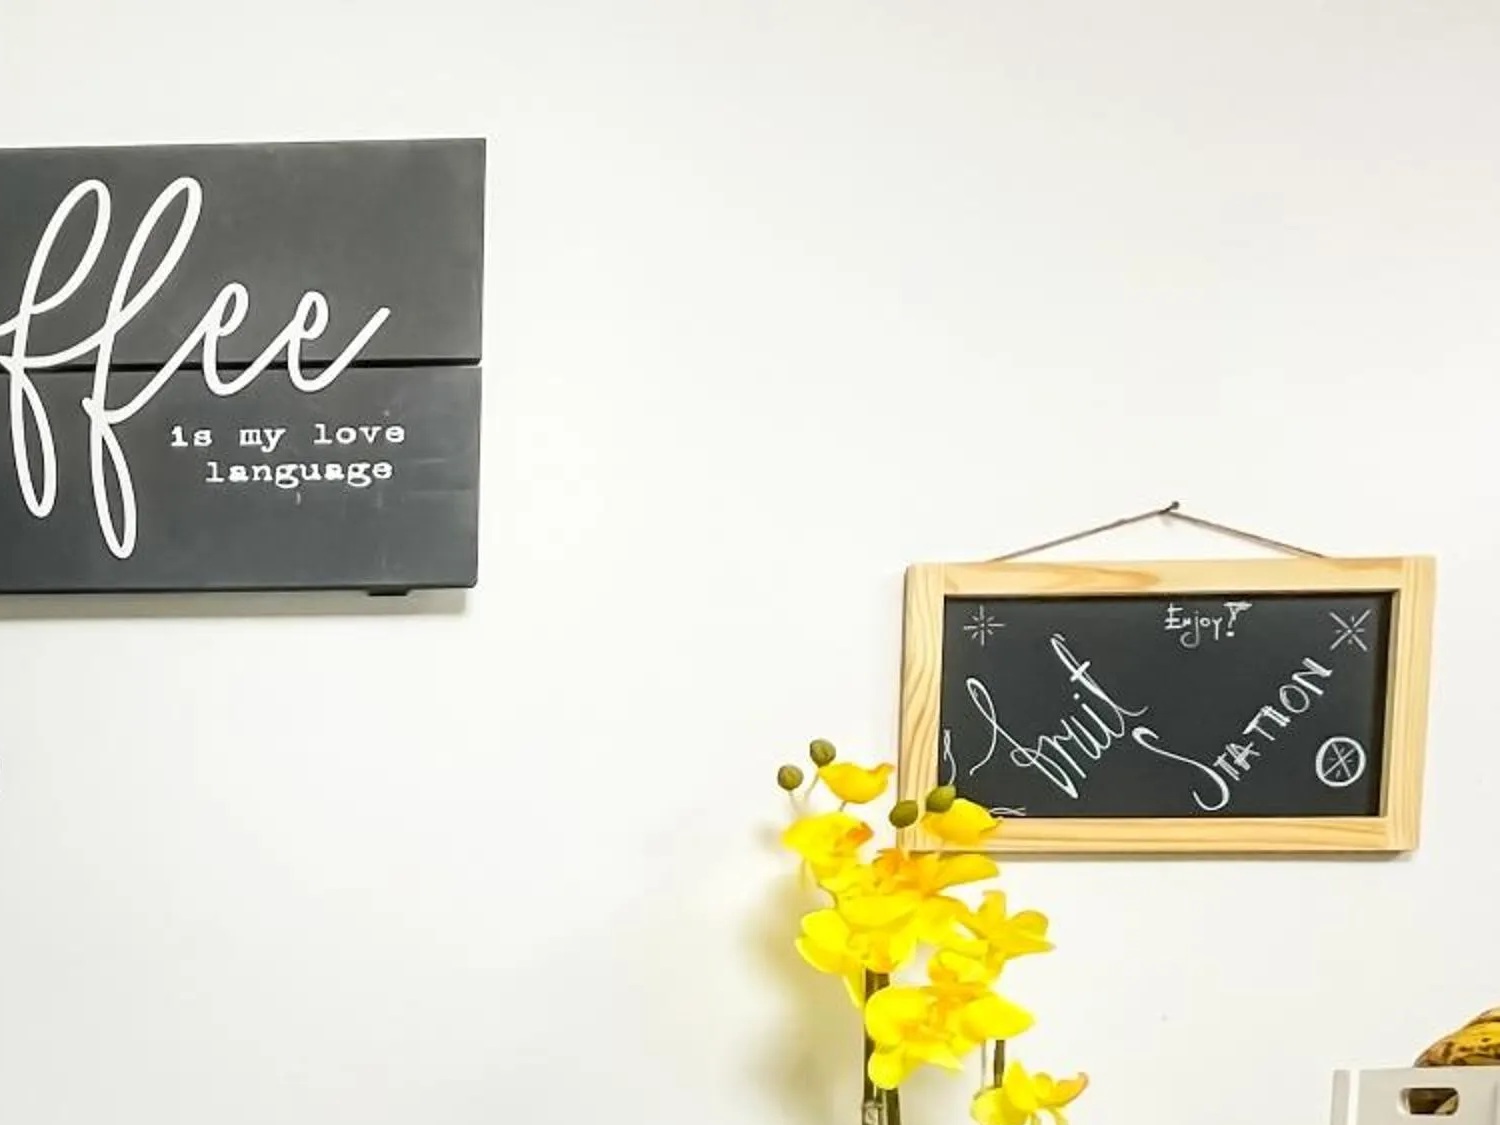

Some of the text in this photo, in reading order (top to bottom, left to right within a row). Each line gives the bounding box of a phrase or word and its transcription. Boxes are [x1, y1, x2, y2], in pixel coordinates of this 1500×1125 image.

[171, 422, 407, 452] is my love
[205, 459, 394, 487] language
